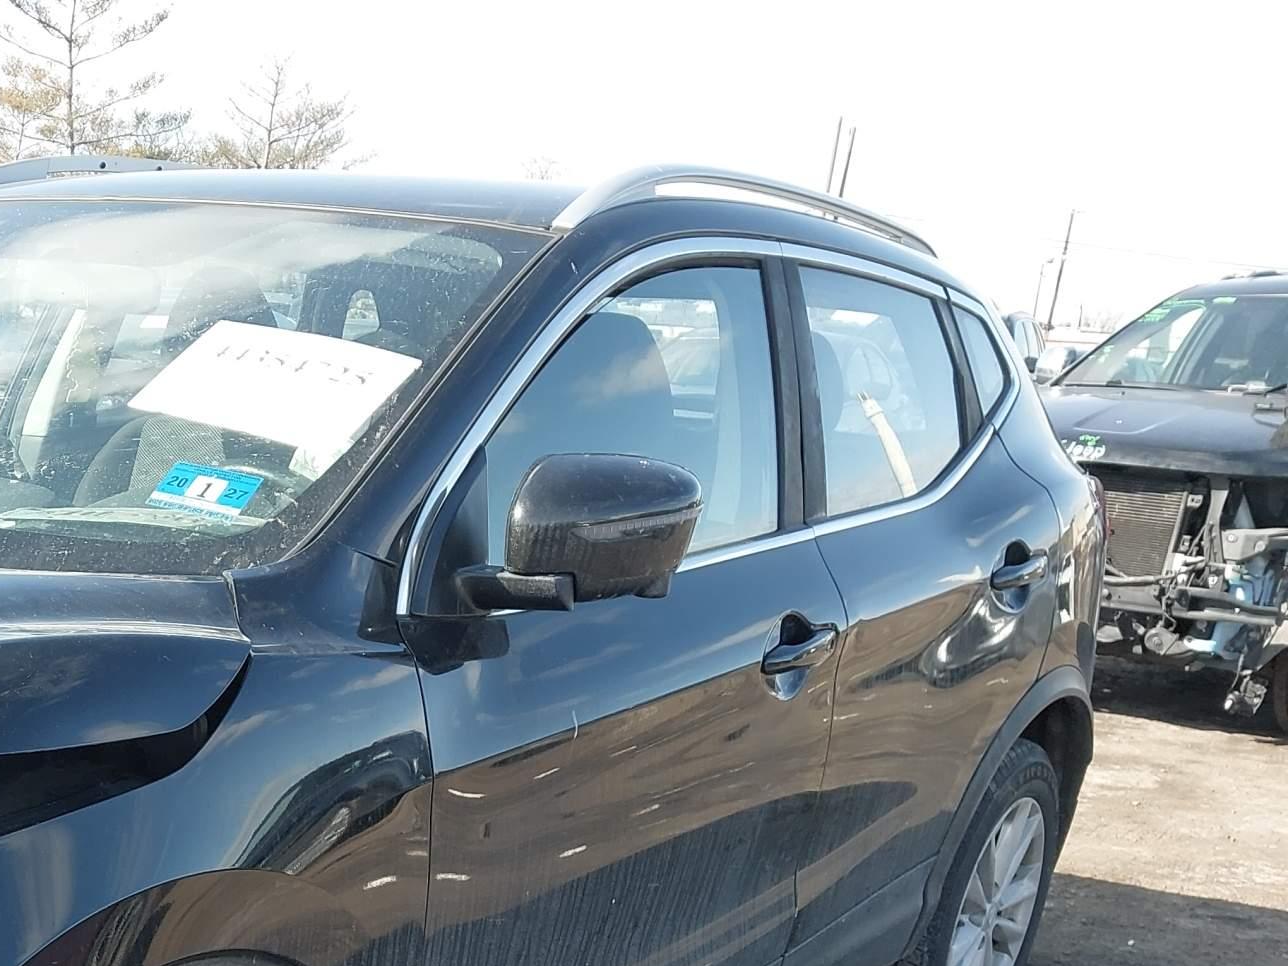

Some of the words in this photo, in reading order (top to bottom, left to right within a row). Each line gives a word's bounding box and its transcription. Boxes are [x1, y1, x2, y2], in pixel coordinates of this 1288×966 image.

[166, 475, 189, 489] 20
[196, 482, 214, 499] 1
[223, 487, 249, 501] 27
